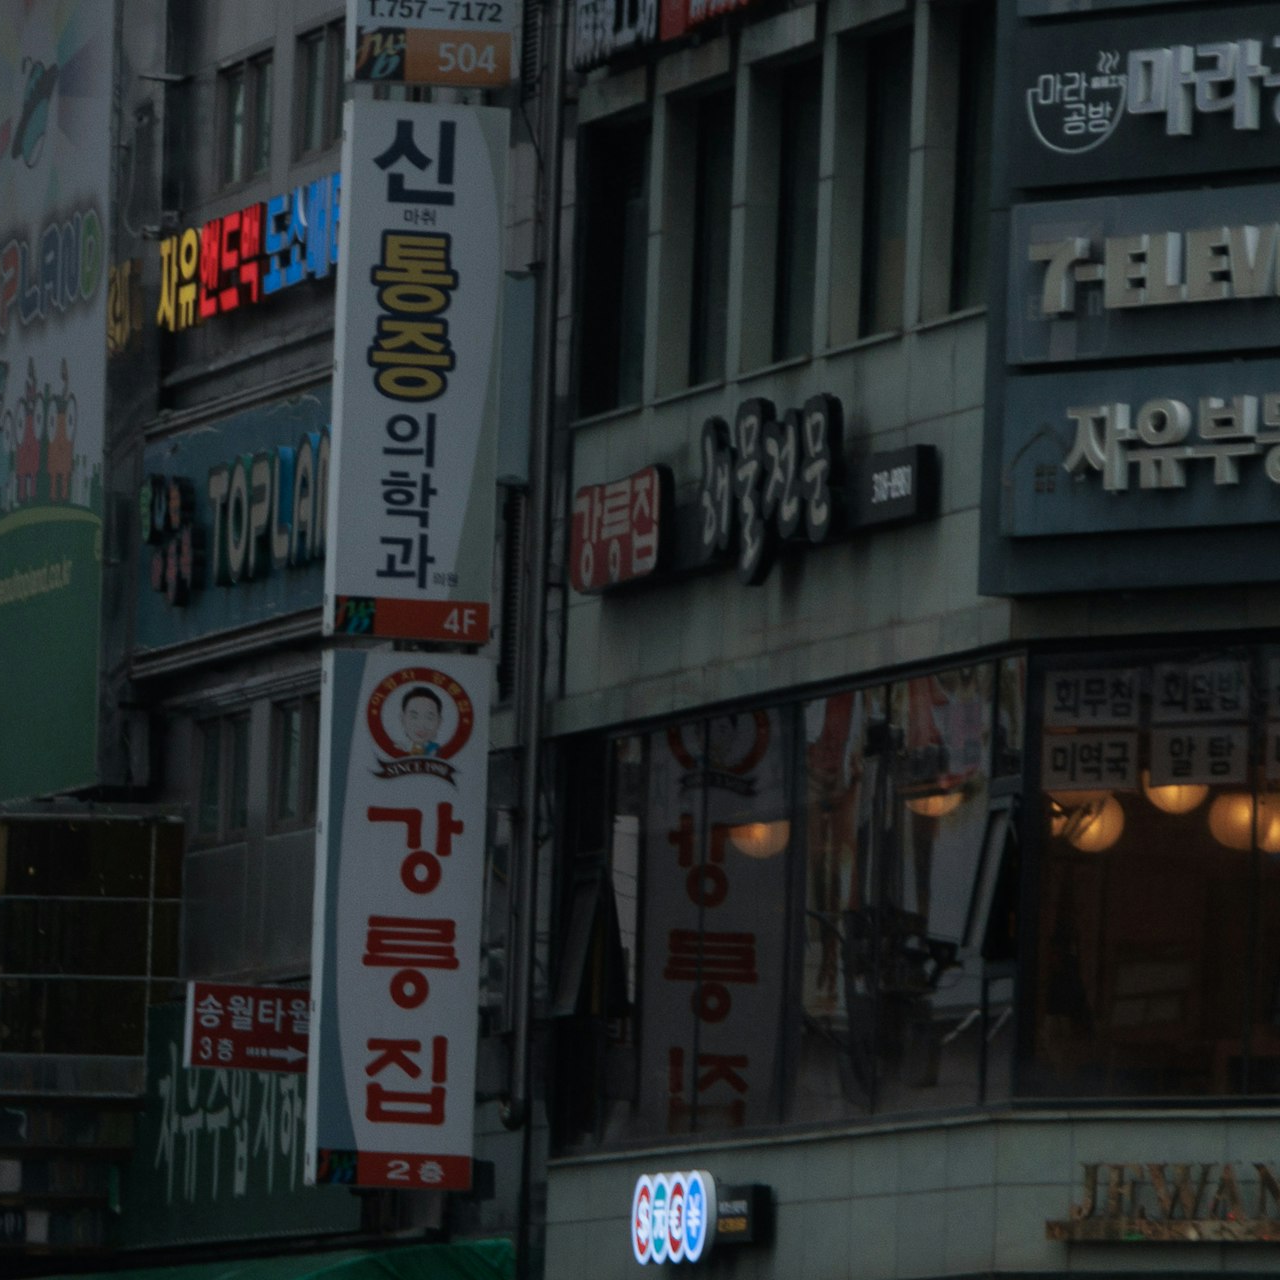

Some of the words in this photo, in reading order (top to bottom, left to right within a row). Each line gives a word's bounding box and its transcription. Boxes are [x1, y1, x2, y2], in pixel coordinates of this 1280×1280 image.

[438, 42, 497, 73] 504
[1038, 71, 1089, 104] 마라
[1127, 37, 1280, 137] 마라
[1062, 101, 1113, 135] 공방
[403, 209, 437, 226] 마취
[1028, 222, 1280, 315] 7-ELEV
[576, 464, 658, 583] 강릉집
[443, 607, 477, 634] 4F
[1053, 678, 1133, 718] 회무침
[1051, 741, 1129, 782] 미역국
[362, 801, 464, 1126] 강릉집
[197, 993, 312, 1036] 송월타월
[199, 1035, 235, 1062] 3층
[386, 1158, 445, 1184] 2층
